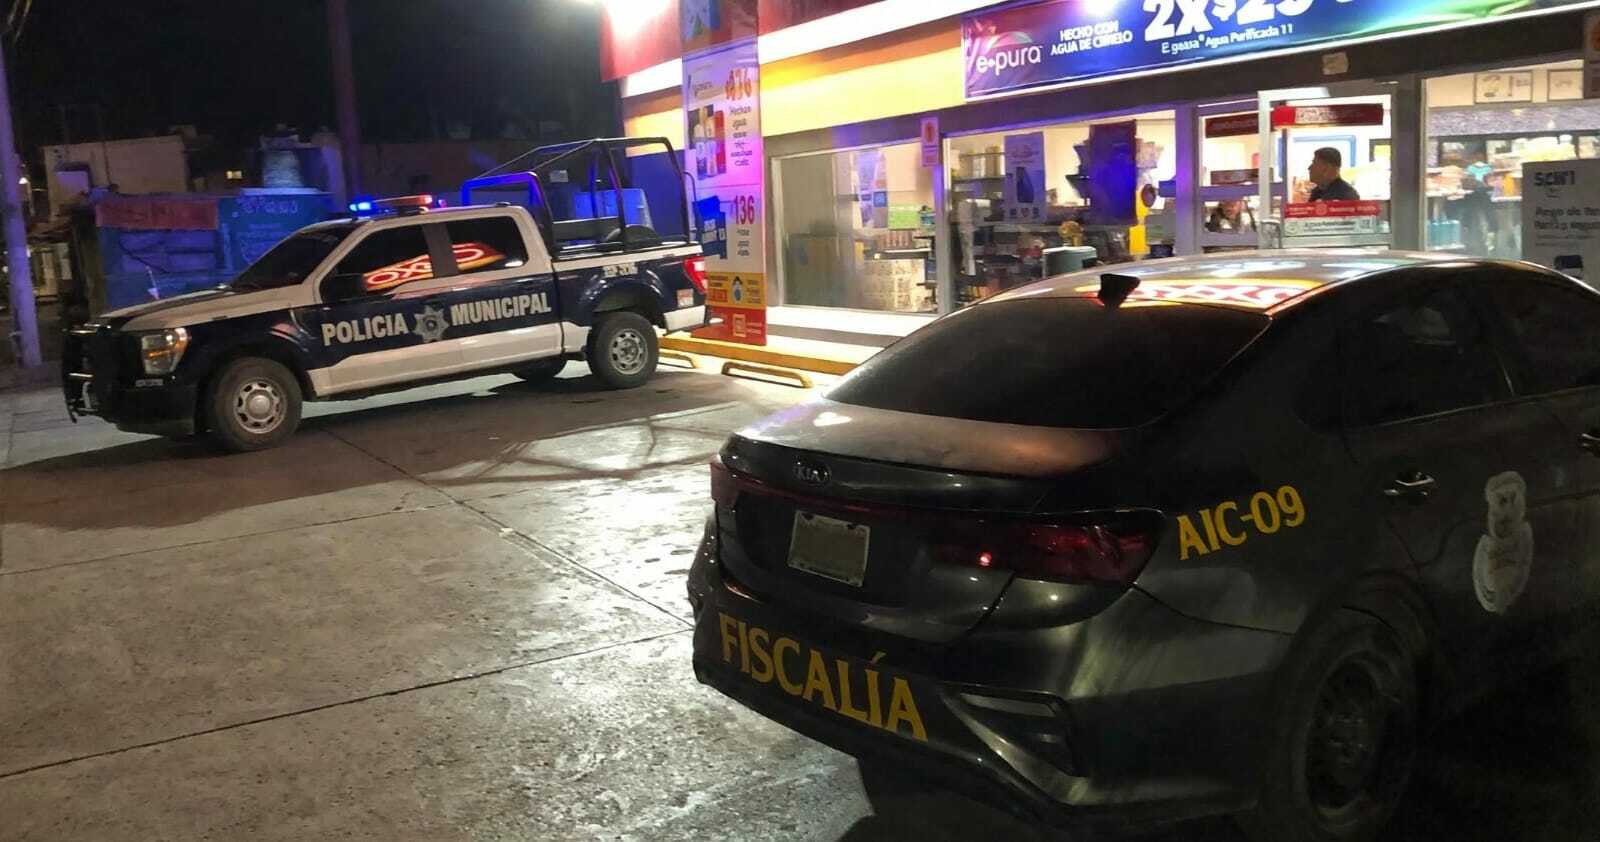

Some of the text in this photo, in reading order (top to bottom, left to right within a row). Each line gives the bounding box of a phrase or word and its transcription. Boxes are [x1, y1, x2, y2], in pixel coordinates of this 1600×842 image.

[1050, 41, 1079, 57] AGUA
[1079, 38, 1092, 51] DE
[1205, 35, 1229, 49] Agua
[1230, 25, 1280, 43] Purificada
[321, 292, 552, 347] POLICIA MUNICIPAL
[1176, 485, 1305, 561] AIC-09
[719, 612, 929, 743] FISCALÍA
